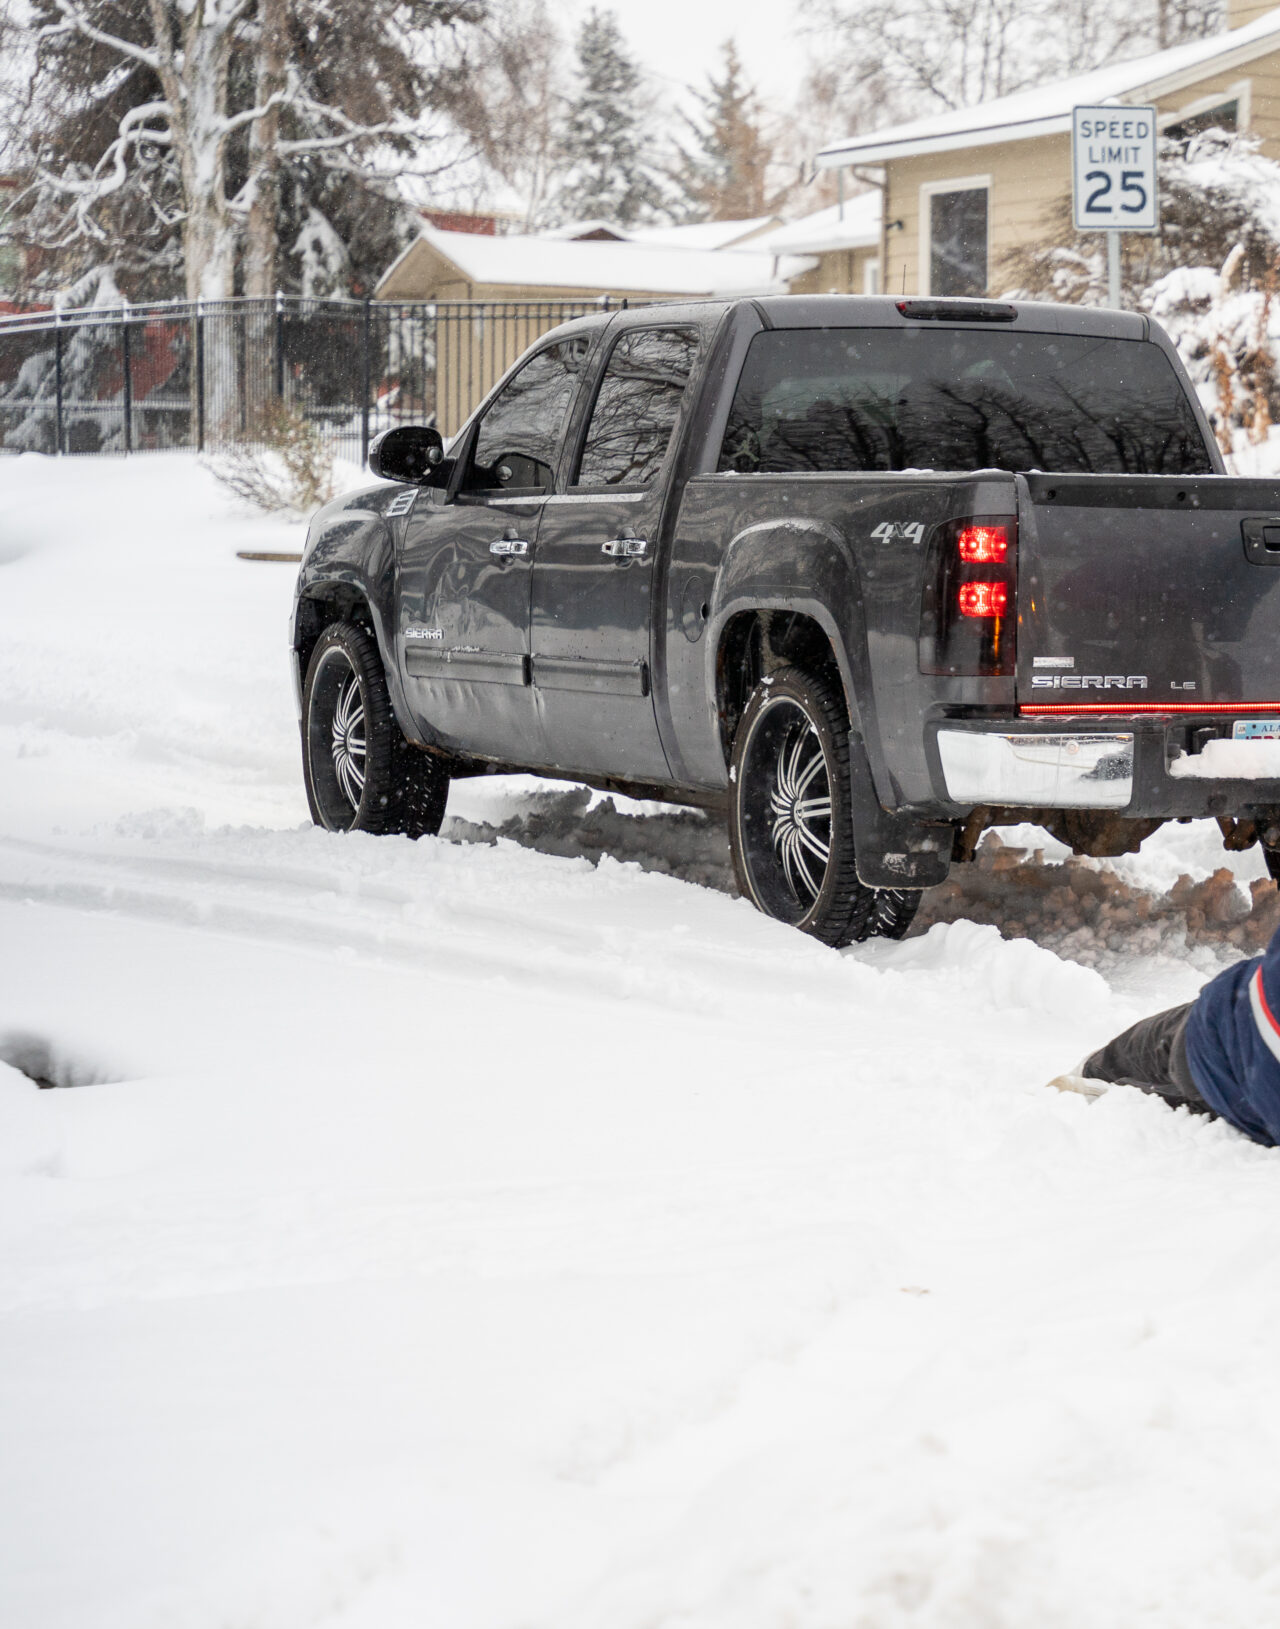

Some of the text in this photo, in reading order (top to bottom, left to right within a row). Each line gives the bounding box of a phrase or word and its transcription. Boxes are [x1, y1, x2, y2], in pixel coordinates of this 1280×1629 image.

[1080, 121, 1149, 139] SPEED
[1088, 146, 1141, 164] LIMIT
[1084, 171, 1147, 213] 25
[405, 627, 444, 640] SIERRA
[1031, 675, 1196, 690] SIERRA LE
